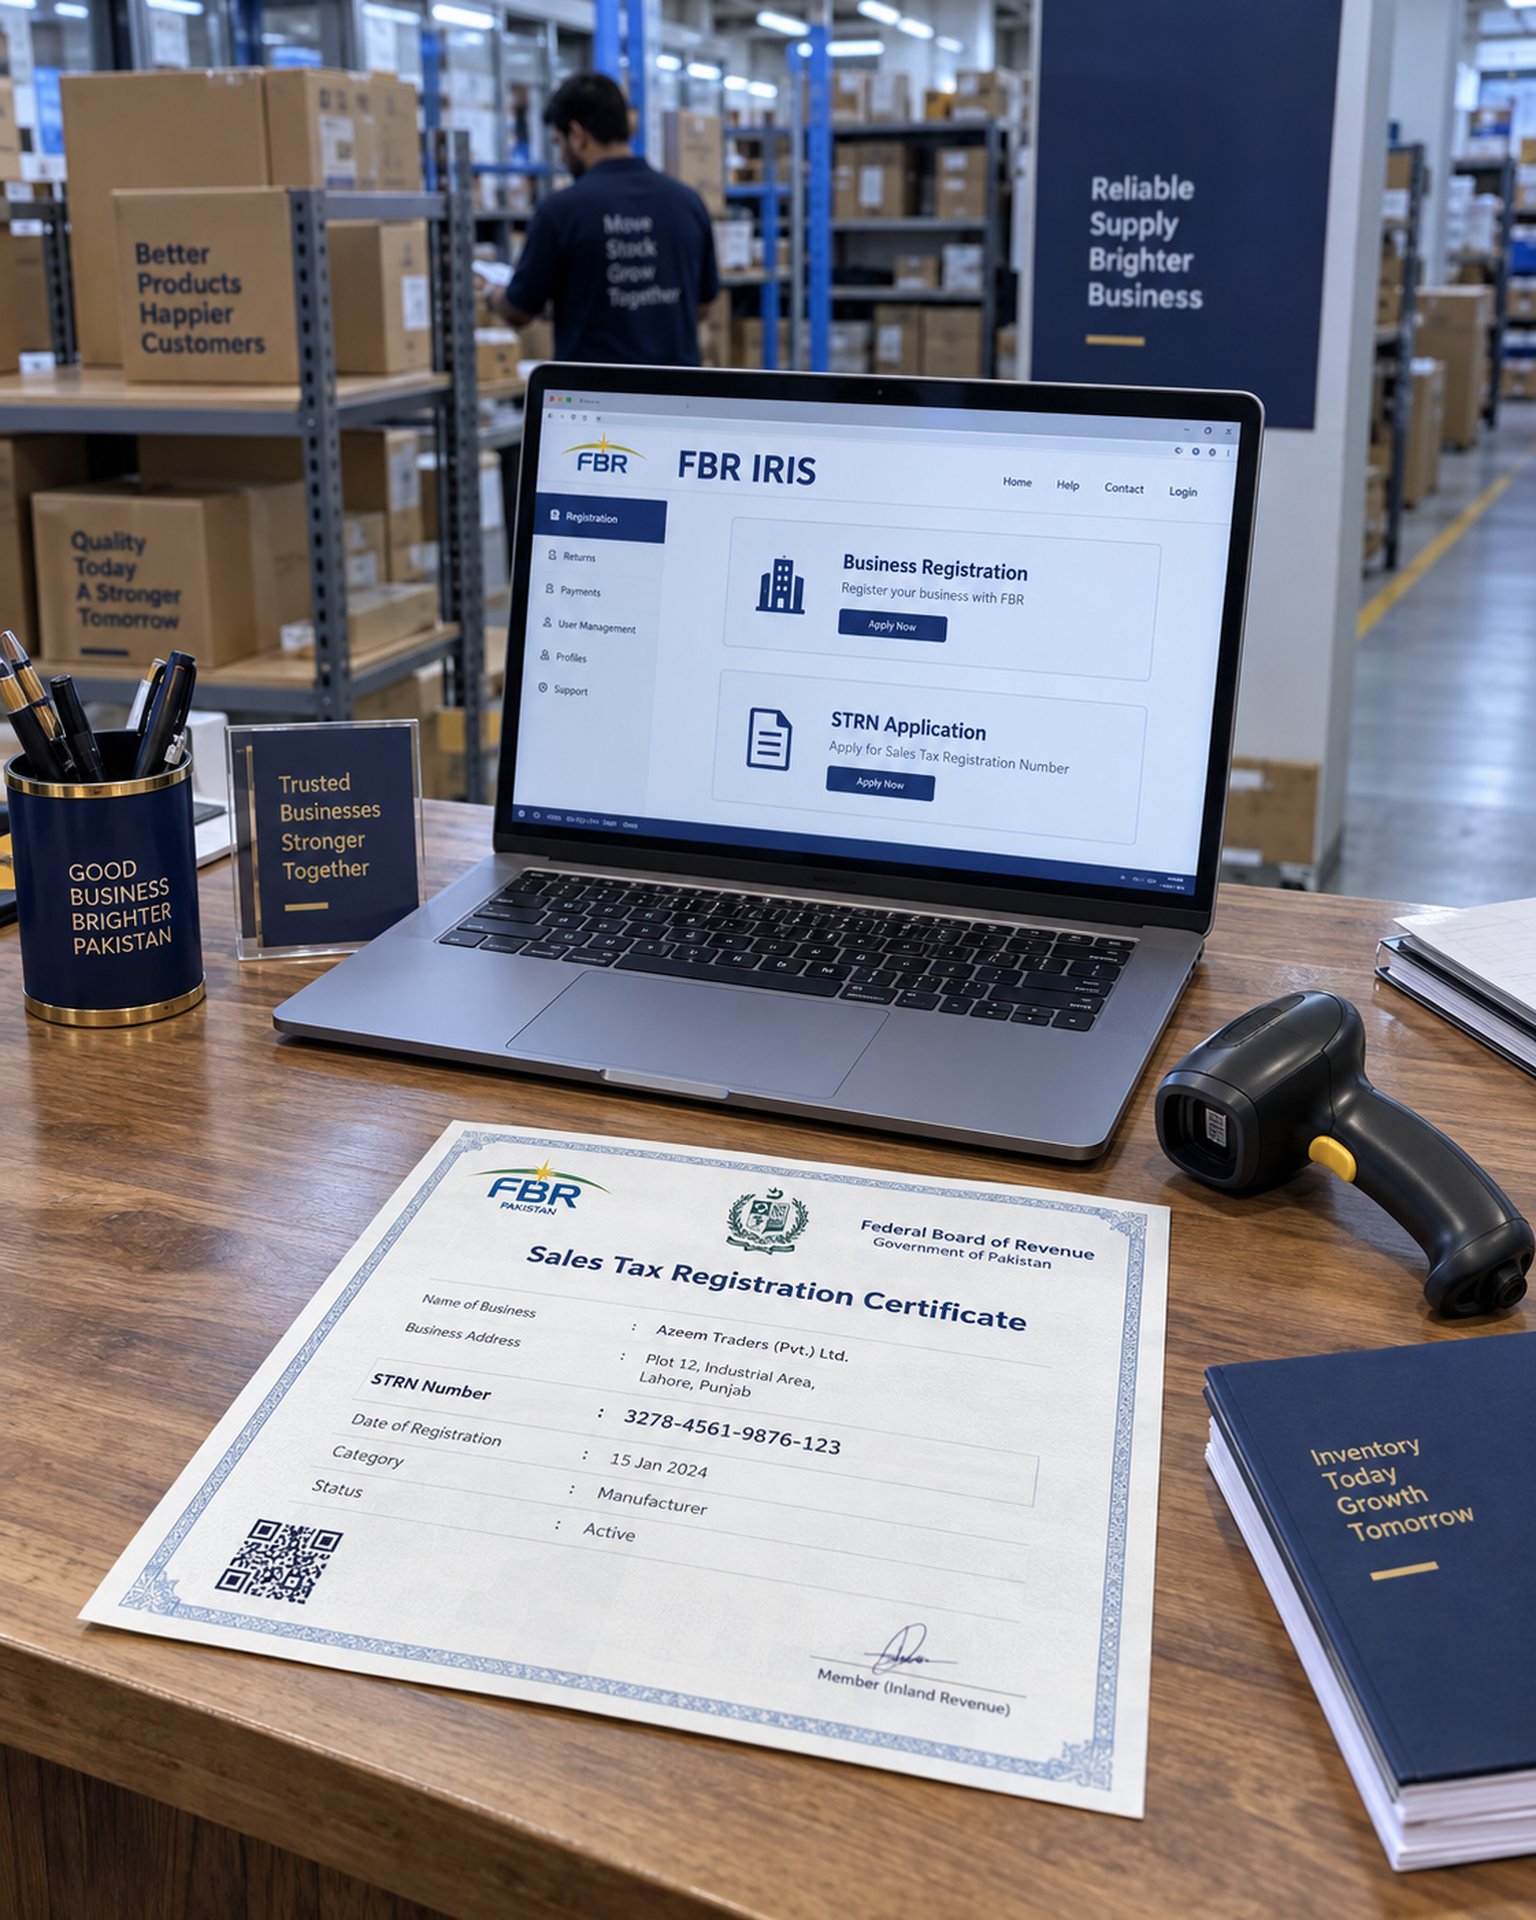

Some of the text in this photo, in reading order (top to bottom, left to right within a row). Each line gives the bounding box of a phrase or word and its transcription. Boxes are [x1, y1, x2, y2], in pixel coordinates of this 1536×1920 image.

[1091, 173, 1195, 201] Reliable
[1089, 209, 1179, 242] Supply
[135, 242, 210, 265] Better
[1089, 245, 1194, 278] Brighter
[138, 272, 242, 295] Products
[1088, 281, 1203, 310] Business
[139, 301, 234, 330] Happier
[142, 332, 266, 354] Customers
[577, 452, 628, 474] FBR
[678, 450, 817, 485] FBR IRIS
[1003, 476, 1033, 488] Home
[1057, 479, 1080, 493] Help
[1104, 482, 1145, 496] Contact
[1169, 486, 1198, 499] Login
[566, 511, 618, 525] Registration
[70, 530, 146, 556] Quality
[74, 556, 137, 583] Today
[563, 552, 596, 563] Returns
[843, 554, 1028, 582] Business Registration
[77, 582, 181, 608] A Stronger
[561, 586, 601, 598] Payments
[842, 581, 1025, 606] Register your business with FBR
[78, 607, 179, 629] Tomorrow
[558, 620, 636, 635] User Management
[868, 619, 917, 633] Apply Now
[556, 652, 587, 664] Profiles
[554, 684, 588, 697] Support
[831, 711, 987, 742] STRN Application
[829, 740, 1069, 775] Apply for Sales Tax Registration Number
[279, 772, 350, 794] Trusted
[856, 777, 905, 790] Apply Now
[280, 803, 381, 823] Businesses
[282, 833, 365, 854] Stronger
[68, 860, 137, 882] GOOD
[283, 860, 370, 884] Together
[70, 877, 169, 906] BUSINESS
[72, 902, 172, 931] BRIGHTER
[73, 926, 172, 956] PAKISTAN
[486, 1176, 582, 1209] FBR
[500, 1201, 557, 1215] PAKISTAN
[861, 1219, 1095, 1261] Federal Board of Revenue
[873, 1237, 1052, 1270] Government of Pakistan
[526, 1245, 1027, 1332] Sales Tax Registration Certificate
[422, 1293, 537, 1319] Name of Business
[405, 1322, 522, 1348] Business Address
[656, 1324, 708, 1342] Azeem
[713, 1332, 769, 1351] Traders
[773, 1340, 816, 1359] (Pvt.)
[819, 1348, 849, 1363] Ltd.
[646, 1353, 674, 1368] Plot
[679, 1359, 701, 1373] 12,
[704, 1361, 773, 1383] Industrial
[776, 1373, 816, 1390] Area,
[370, 1373, 492, 1401] STRN Number
[639, 1371, 752, 1399] Lahore, Punjab
[351, 1413, 503, 1447] Date of Registration
[623, 1409, 842, 1456] 3278-4561-9876-123
[331, 1445, 404, 1470] Category
[610, 1452, 631, 1467] 15
[634, 1457, 663, 1472] Jan
[666, 1461, 708, 1479] 2024
[1311, 1439, 1420, 1466] Inventory
[311, 1479, 364, 1499] Status
[1321, 1467, 1397, 1490] Today
[597, 1486, 708, 1516] Manufacturer
[1337, 1485, 1429, 1515] Growth
[583, 1522, 637, 1543] Active
[1347, 1507, 1474, 1542] Tomorrow
[817, 1668, 1011, 1718] Member (Inland Revenue)
